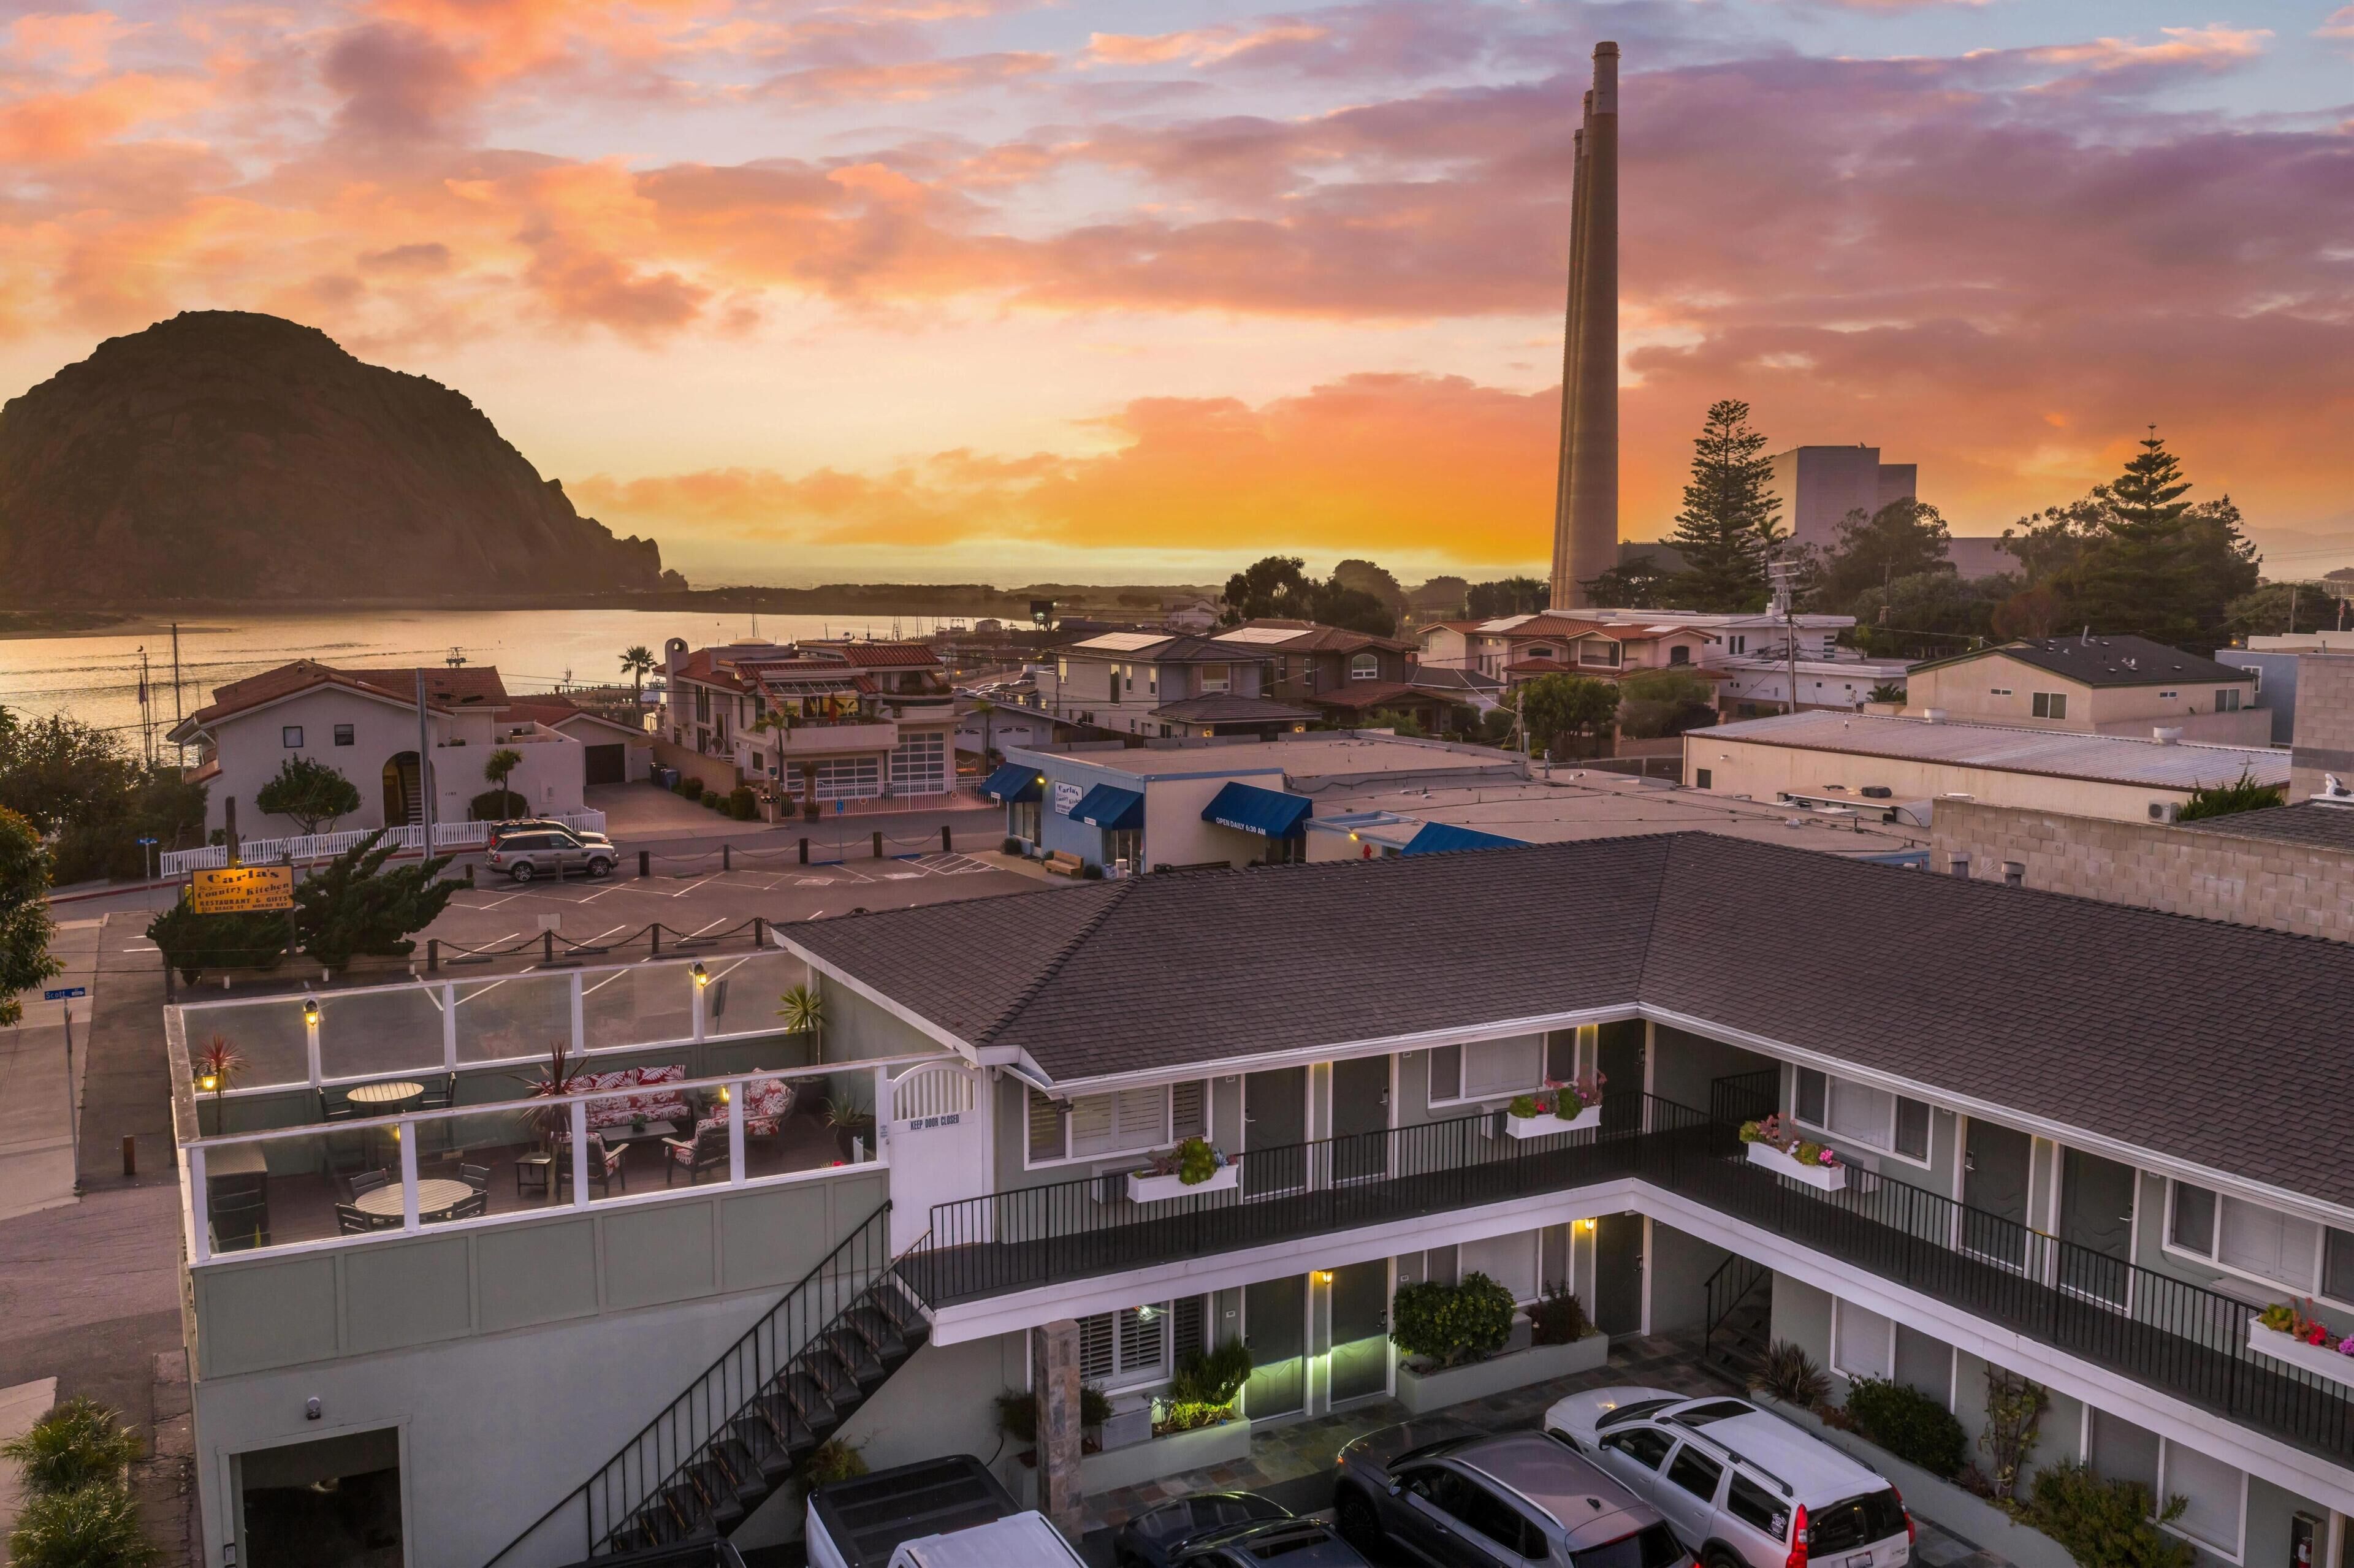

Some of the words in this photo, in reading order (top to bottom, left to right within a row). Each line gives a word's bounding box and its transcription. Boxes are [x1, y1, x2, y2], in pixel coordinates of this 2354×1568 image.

[1059, 785, 1078, 796] Carla's
[1216, 817, 1229, 827] OPEN
[1230, 821, 1244, 830] DAILY
[1246, 824, 1256, 833] 6:30
[207, 869, 280, 883] Carla's
[197, 886, 242, 899] Country
[246, 883, 289, 896] Kitchen
[910, 1120, 923, 1130] KEEP
[925, 1117, 939, 1128] DOOR
[941, 1114, 959, 1126] CLOSED
